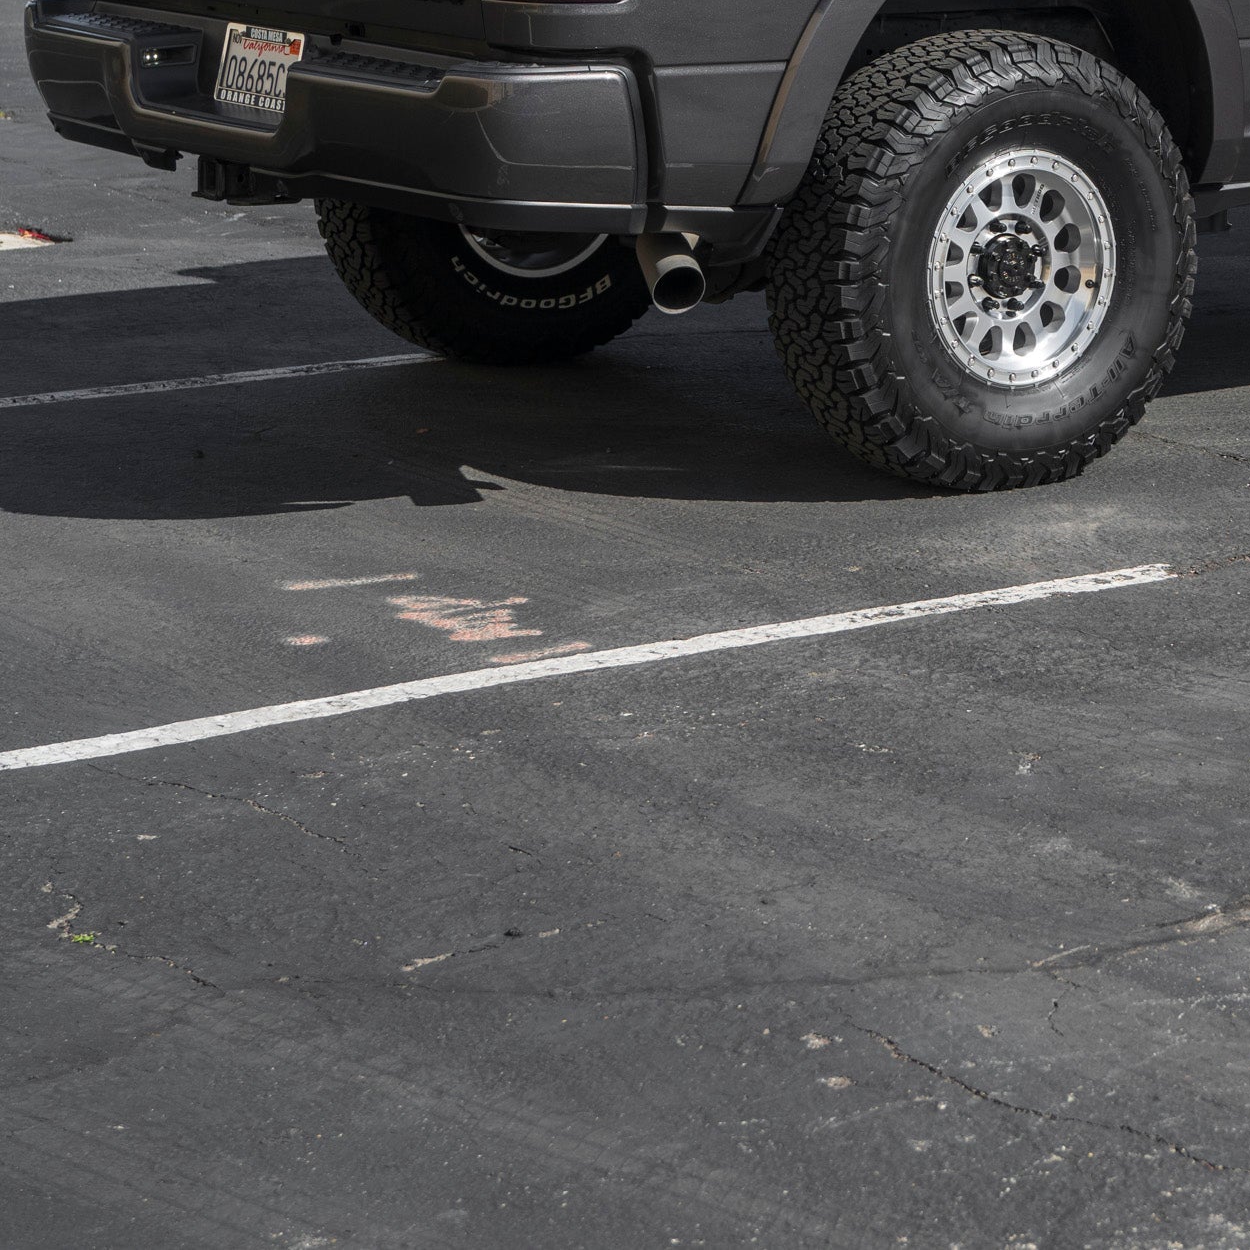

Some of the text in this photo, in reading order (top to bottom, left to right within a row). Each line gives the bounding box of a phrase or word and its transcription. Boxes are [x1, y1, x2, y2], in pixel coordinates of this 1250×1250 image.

[242, 38, 290, 57] California
[250, 27, 283, 42] COSTA MESA
[226, 55, 286, 97] 08685C
[220, 89, 256, 105] ORANGE
[449, 255, 613, 310] BFGoodrich
[983, 332, 1137, 428] All-Terrain
